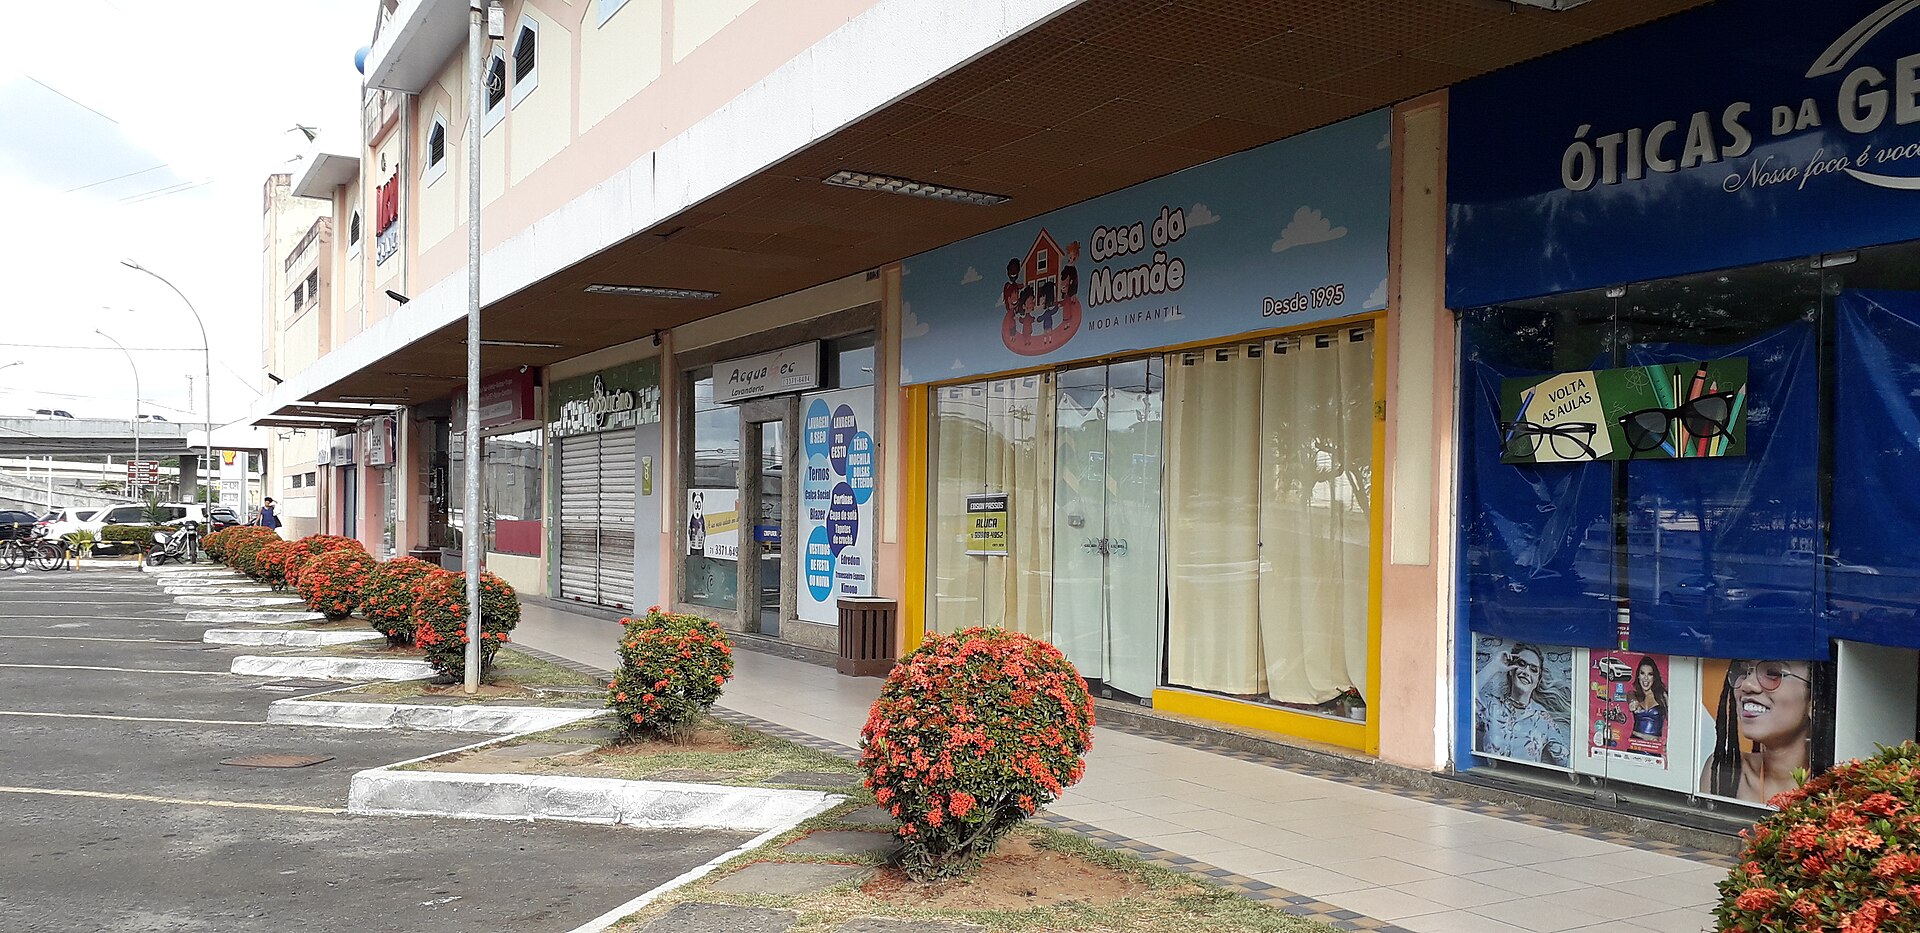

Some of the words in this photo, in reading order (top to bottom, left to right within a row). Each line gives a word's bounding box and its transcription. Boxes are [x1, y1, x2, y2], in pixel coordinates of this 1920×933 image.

[1561, 101, 1753, 191] ÓTICAS
[1772, 98, 1822, 136] DA
[1723, 155, 1800, 193] Nosso
[1798, 147, 1851, 191] foco
[1855, 144, 1872, 167] é
[1874, 141, 1920, 163] voc
[1090, 220, 1145, 263] Casa
[1151, 205, 1186, 248] da
[1088, 250, 1185, 308] Mamãe
[1263, 291, 1308, 317] Desde
[1310, 283, 1345, 309] 1995
[1088, 317, 1119, 331] MODA
[1124, 305, 1182, 325] INFANTIL
[1542, 409, 1556, 424] AS
[1557, 391, 1592, 417] AULAS
[1548, 378, 1586, 403] VOLTA
[975, 518, 998, 529] ALUGA
